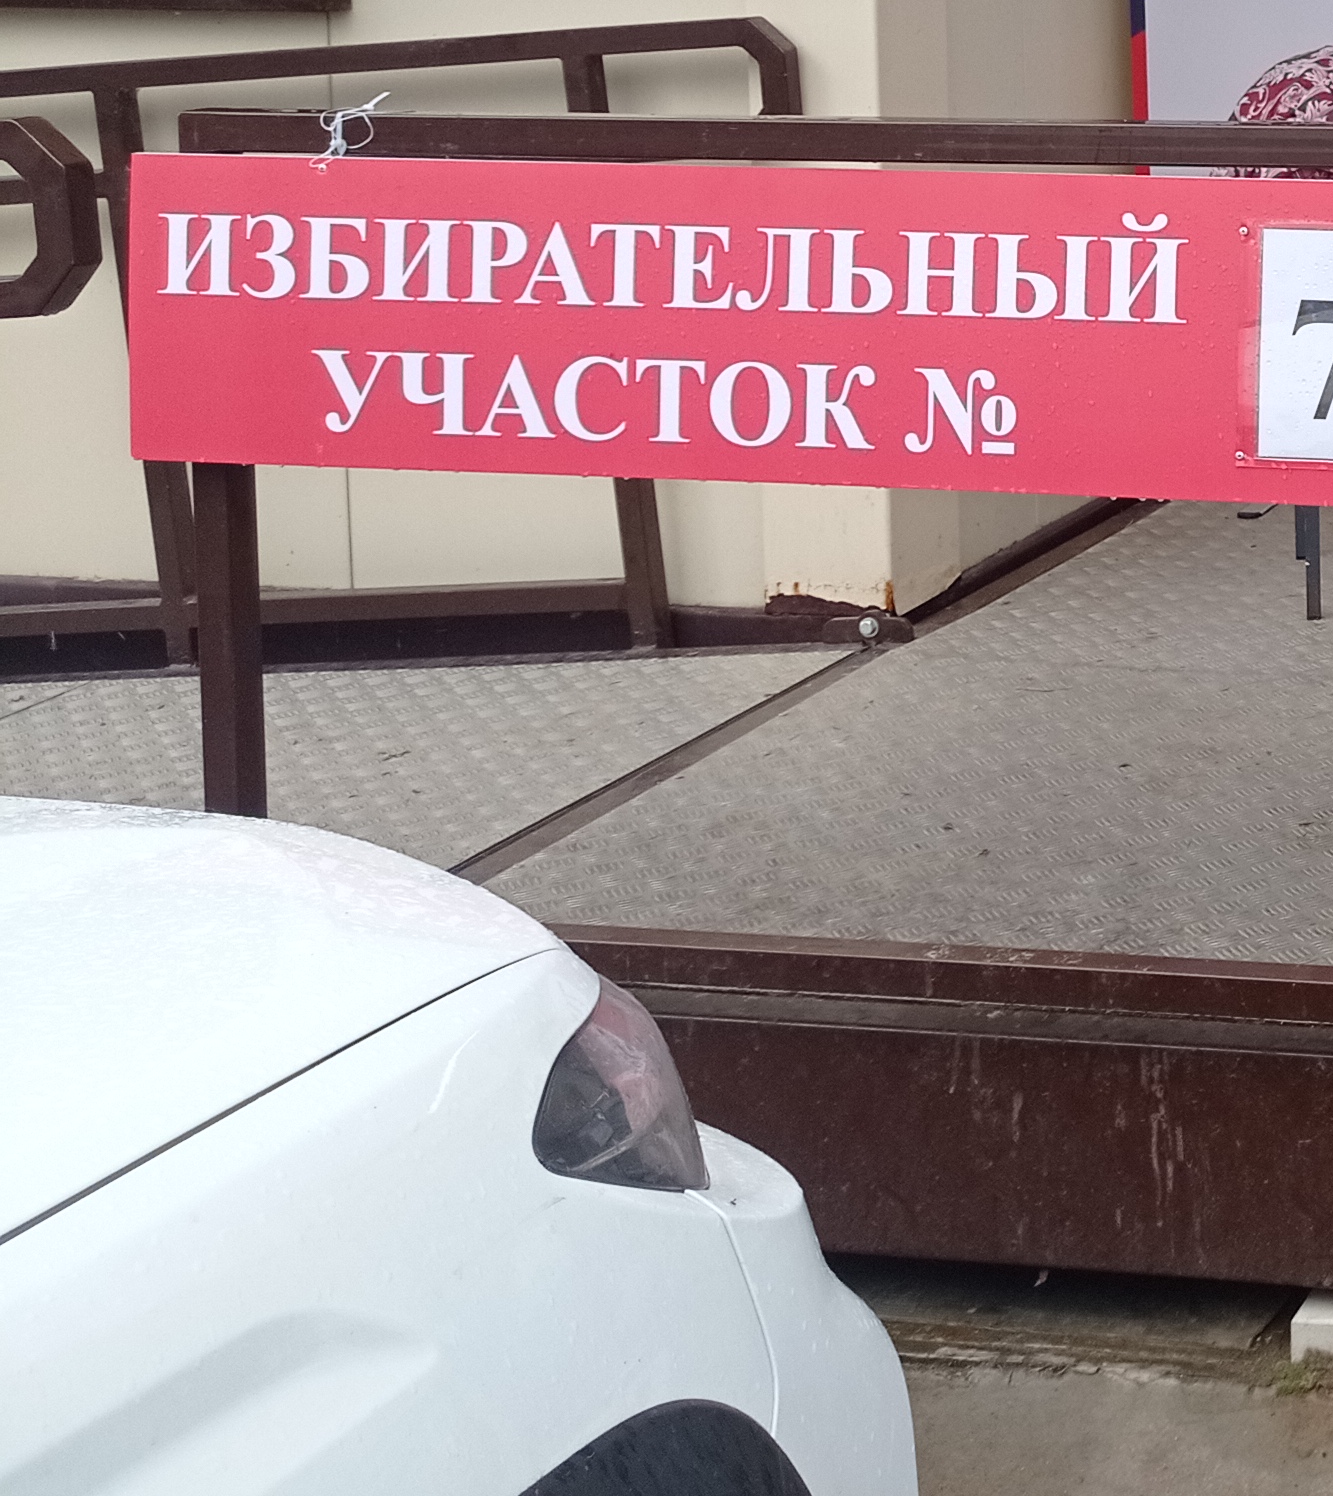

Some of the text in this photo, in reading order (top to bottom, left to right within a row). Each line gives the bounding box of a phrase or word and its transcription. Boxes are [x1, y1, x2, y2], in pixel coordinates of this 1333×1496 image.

[158, 210, 1189, 326] ИЗБИРАТЕЛЬНЫЙ
[312, 347, 1018, 457] УЧАСТОК №
